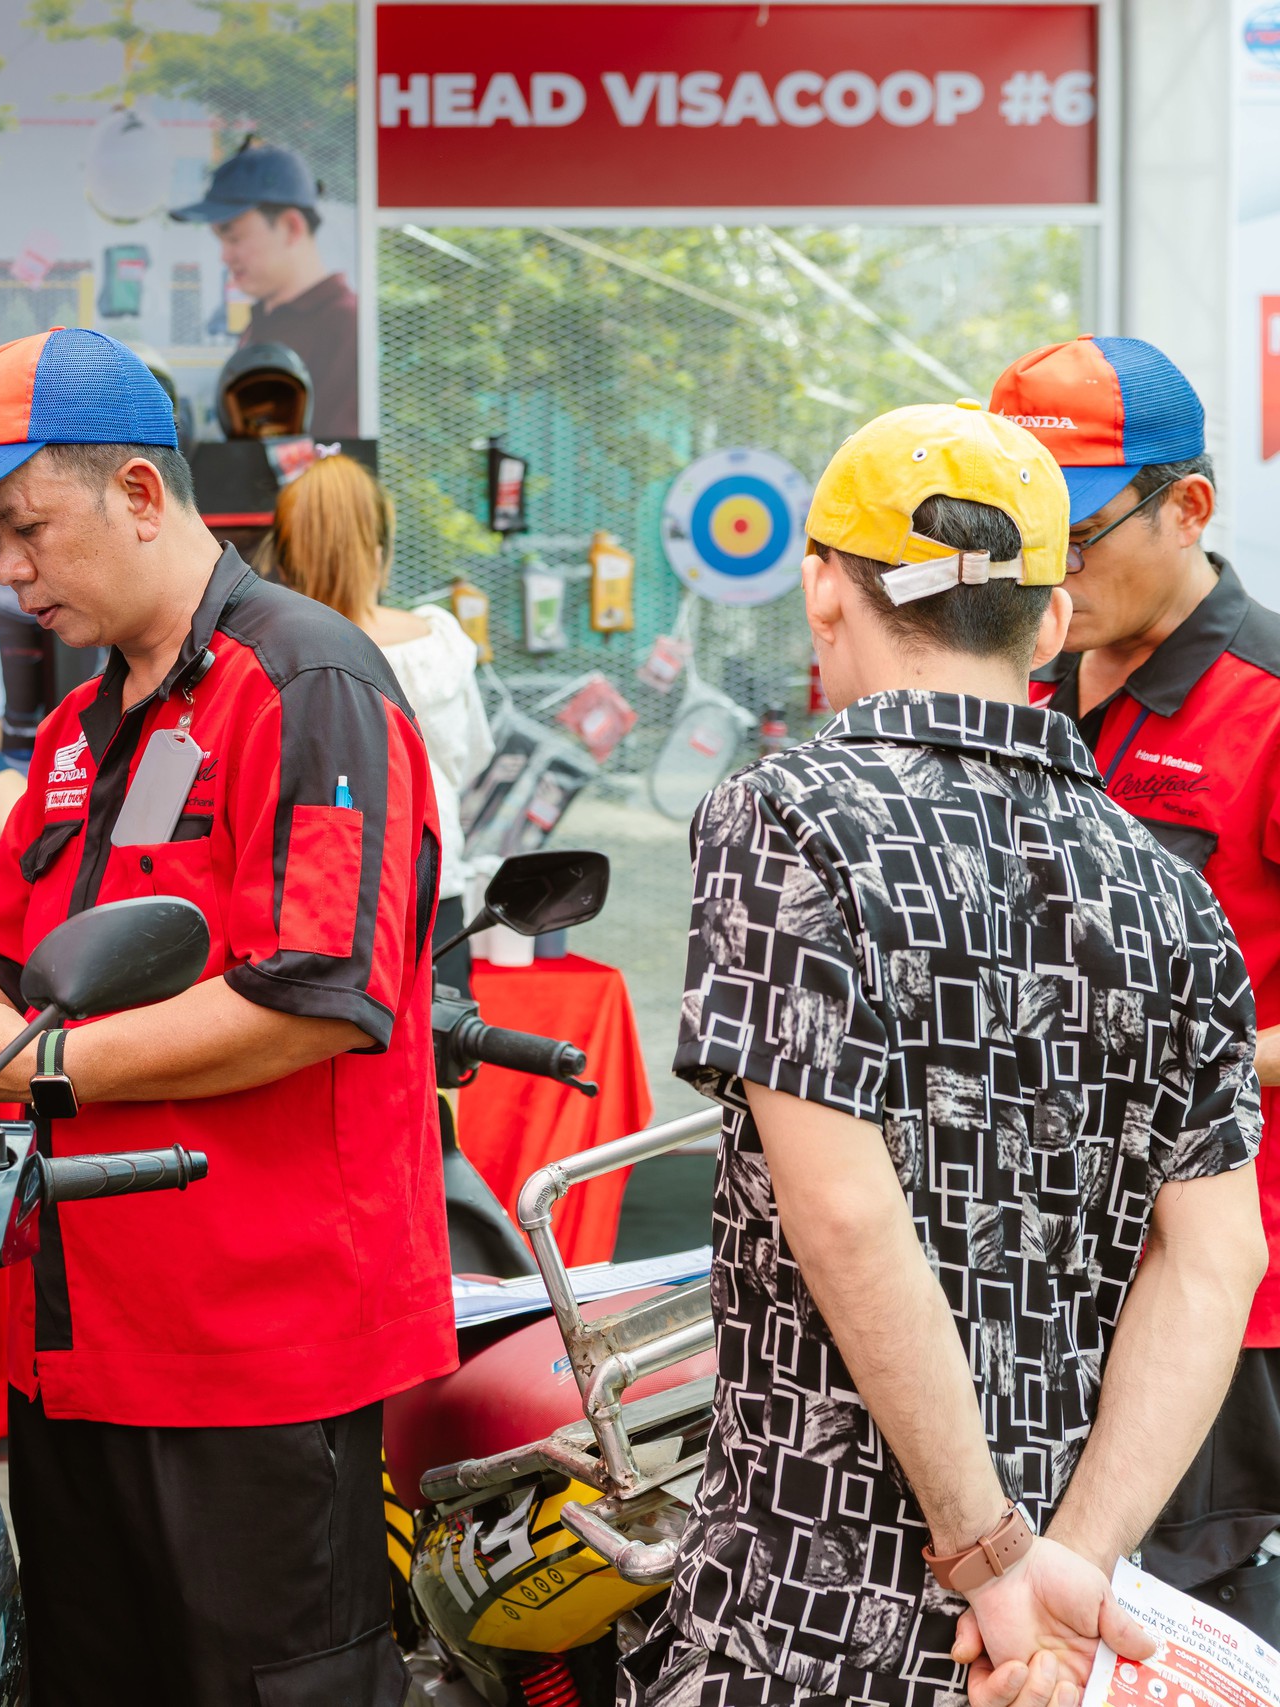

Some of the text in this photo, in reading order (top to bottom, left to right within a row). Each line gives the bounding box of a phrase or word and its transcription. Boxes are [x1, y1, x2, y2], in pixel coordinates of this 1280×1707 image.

[379, 70, 1096, 128] HEAD VISACOOP #6
[48, 767, 87, 784] HONDA
[1161, 755, 1202, 773] Vietnam
[1112, 773, 1211, 803] Certified
[1117, 1597, 1141, 1617] ĐỊNH
[1142, 1612, 1157, 1628] GIÁ
[1198, 1641, 1215, 1658] ĐÃI
[1238, 1667, 1255, 1684] LÊN
[1150, 1607, 1165, 1620] THU
[1166, 1616, 1176, 1626] XE
[1208, 1638, 1217, 1648] XE
[1191, 1615, 1239, 1650] Honda
